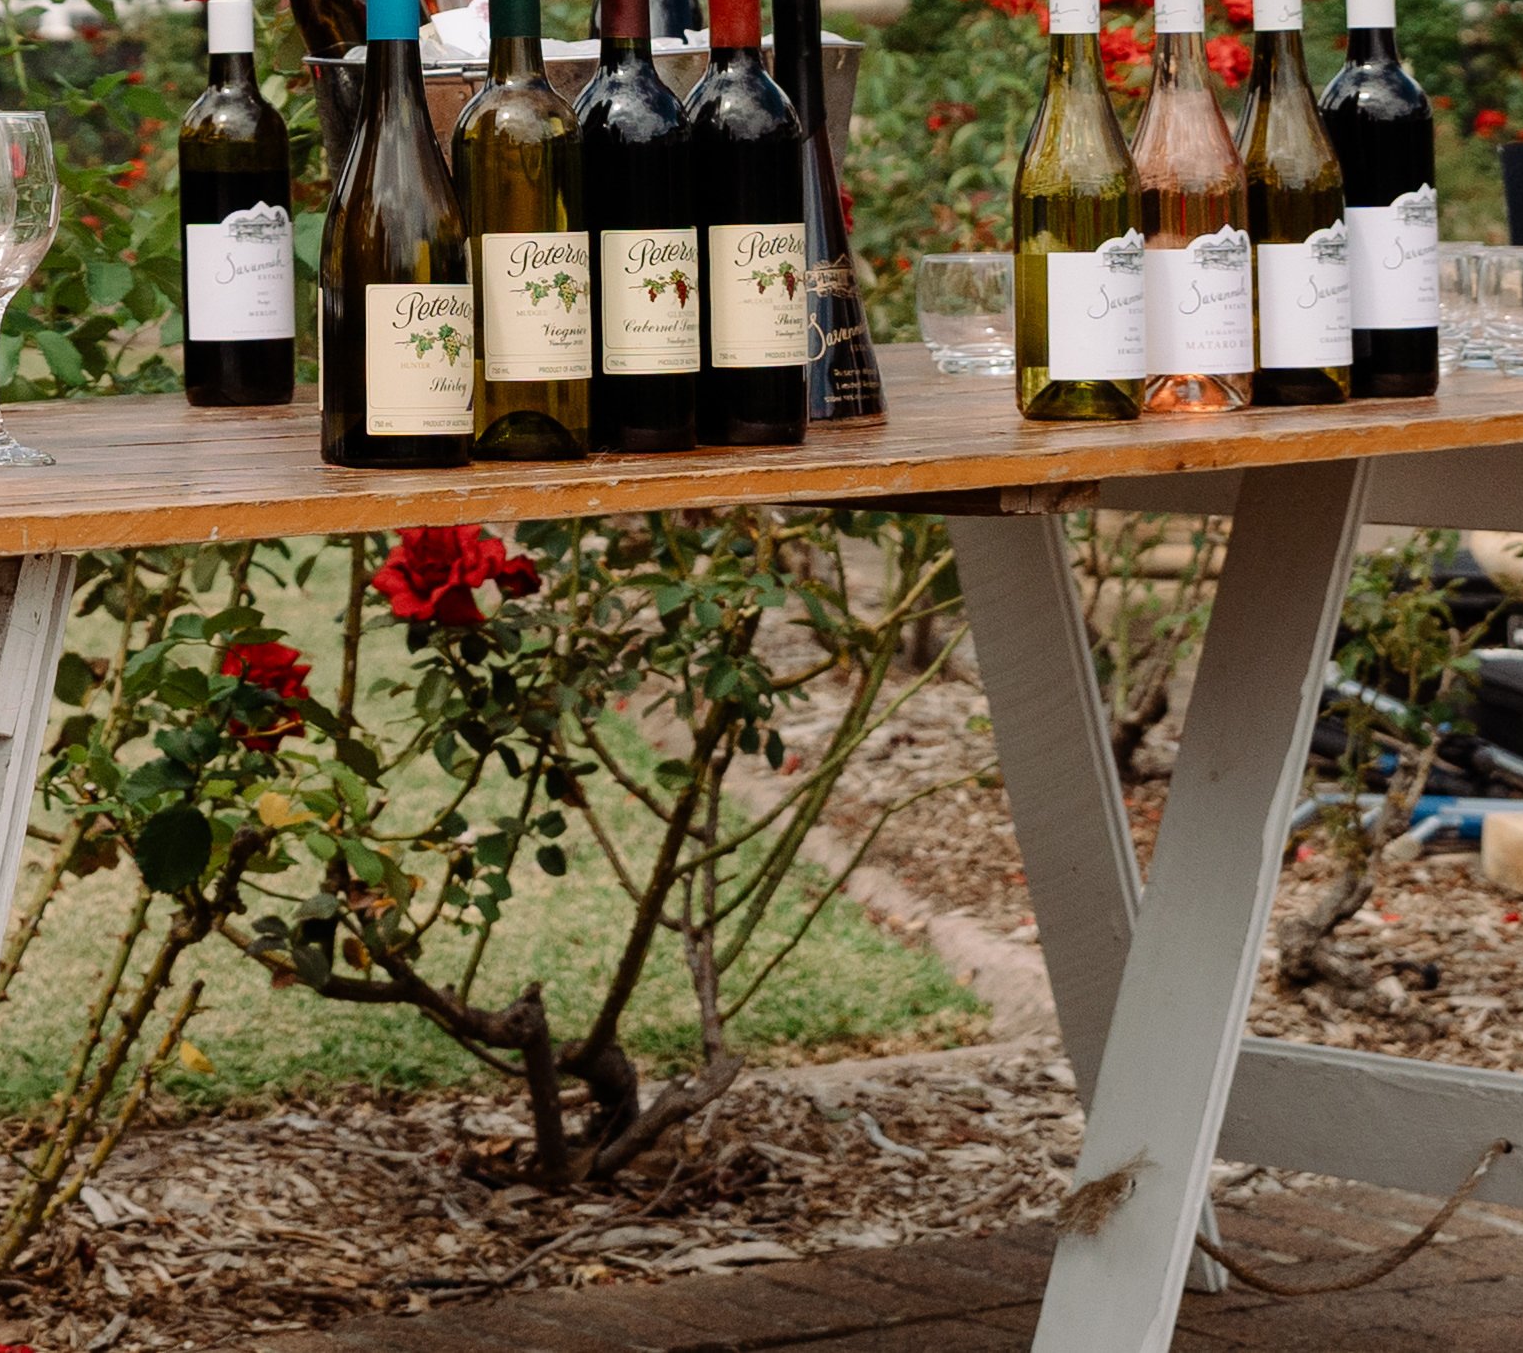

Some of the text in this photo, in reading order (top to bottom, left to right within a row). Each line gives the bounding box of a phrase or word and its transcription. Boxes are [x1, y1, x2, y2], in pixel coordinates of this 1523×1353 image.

[215, 248, 288, 285] Savannah
[507, 240, 588, 278] Peterso
[392, 291, 473, 329] Peterso
[623, 318, 679, 333] Cabernet
[1185, 340, 1237, 350] MATARO
